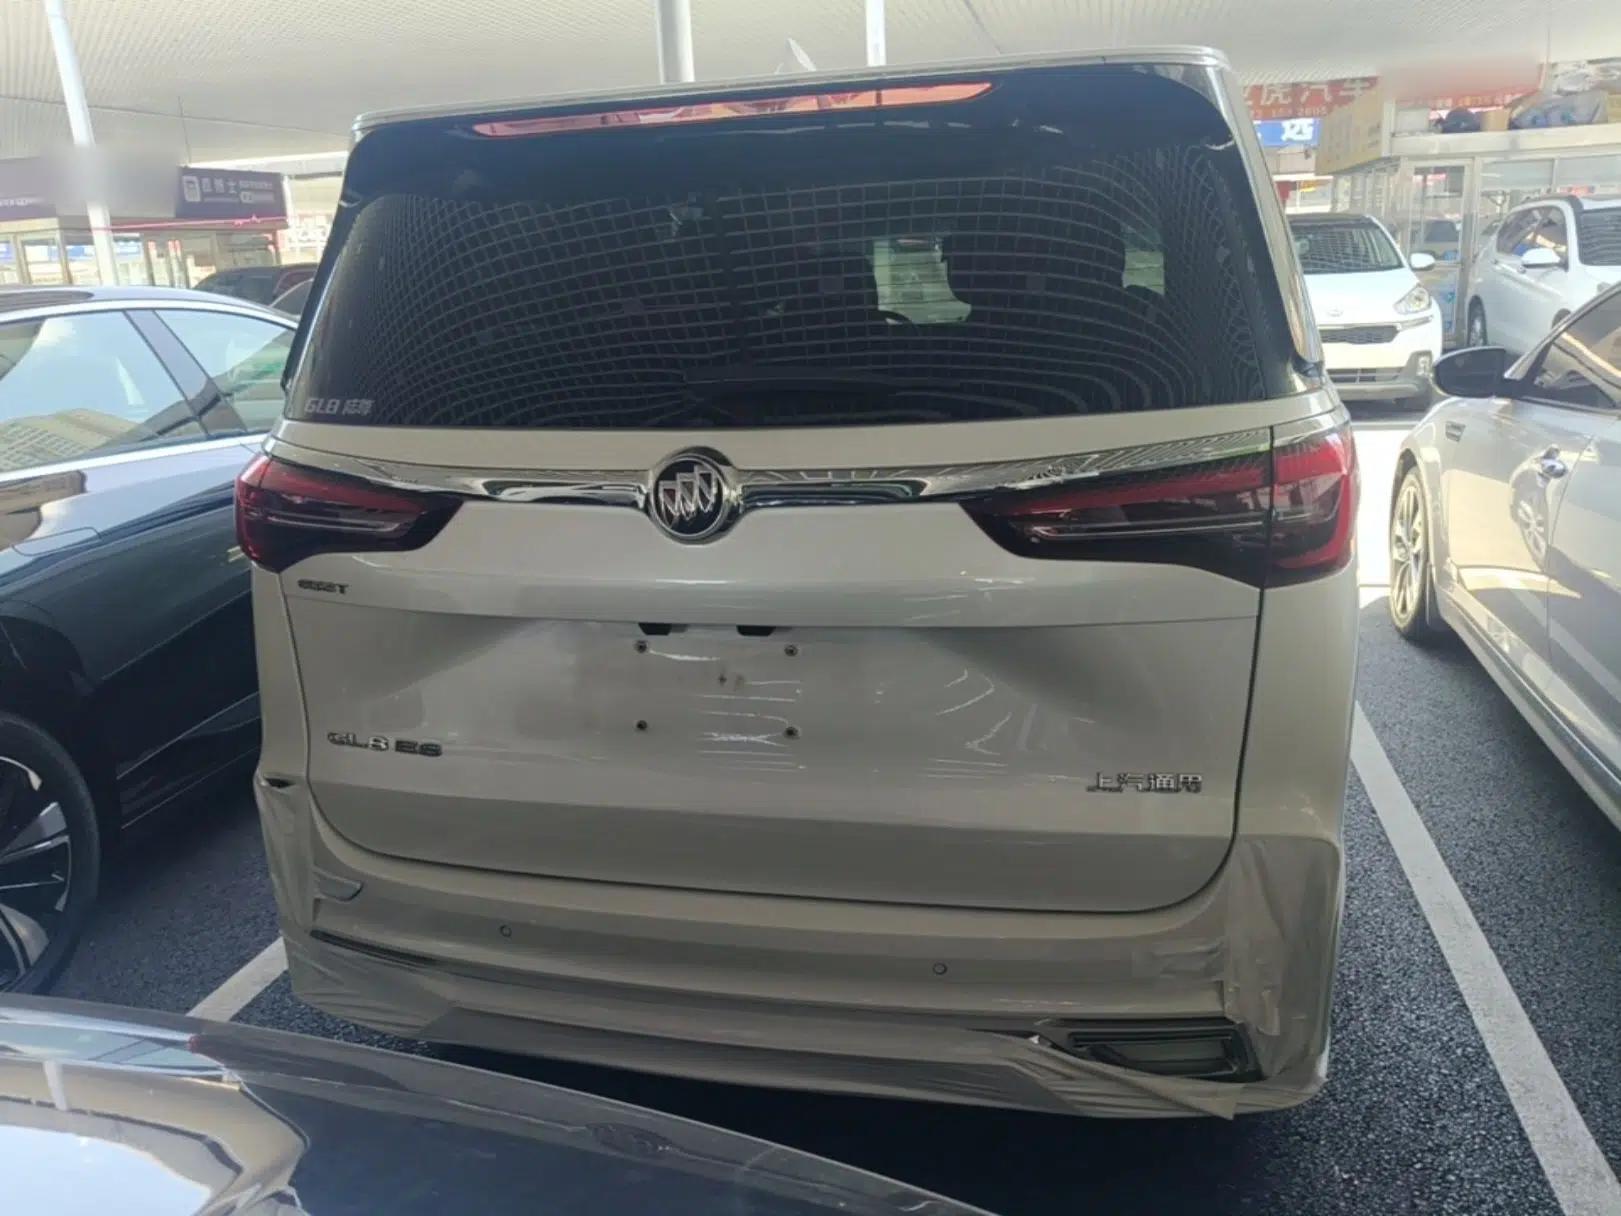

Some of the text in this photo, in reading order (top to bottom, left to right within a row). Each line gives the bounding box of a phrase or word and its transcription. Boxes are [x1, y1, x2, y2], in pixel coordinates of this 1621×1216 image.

[327, 732, 389, 752] GL8
[1086, 771, 1202, 793] 上汽通用
